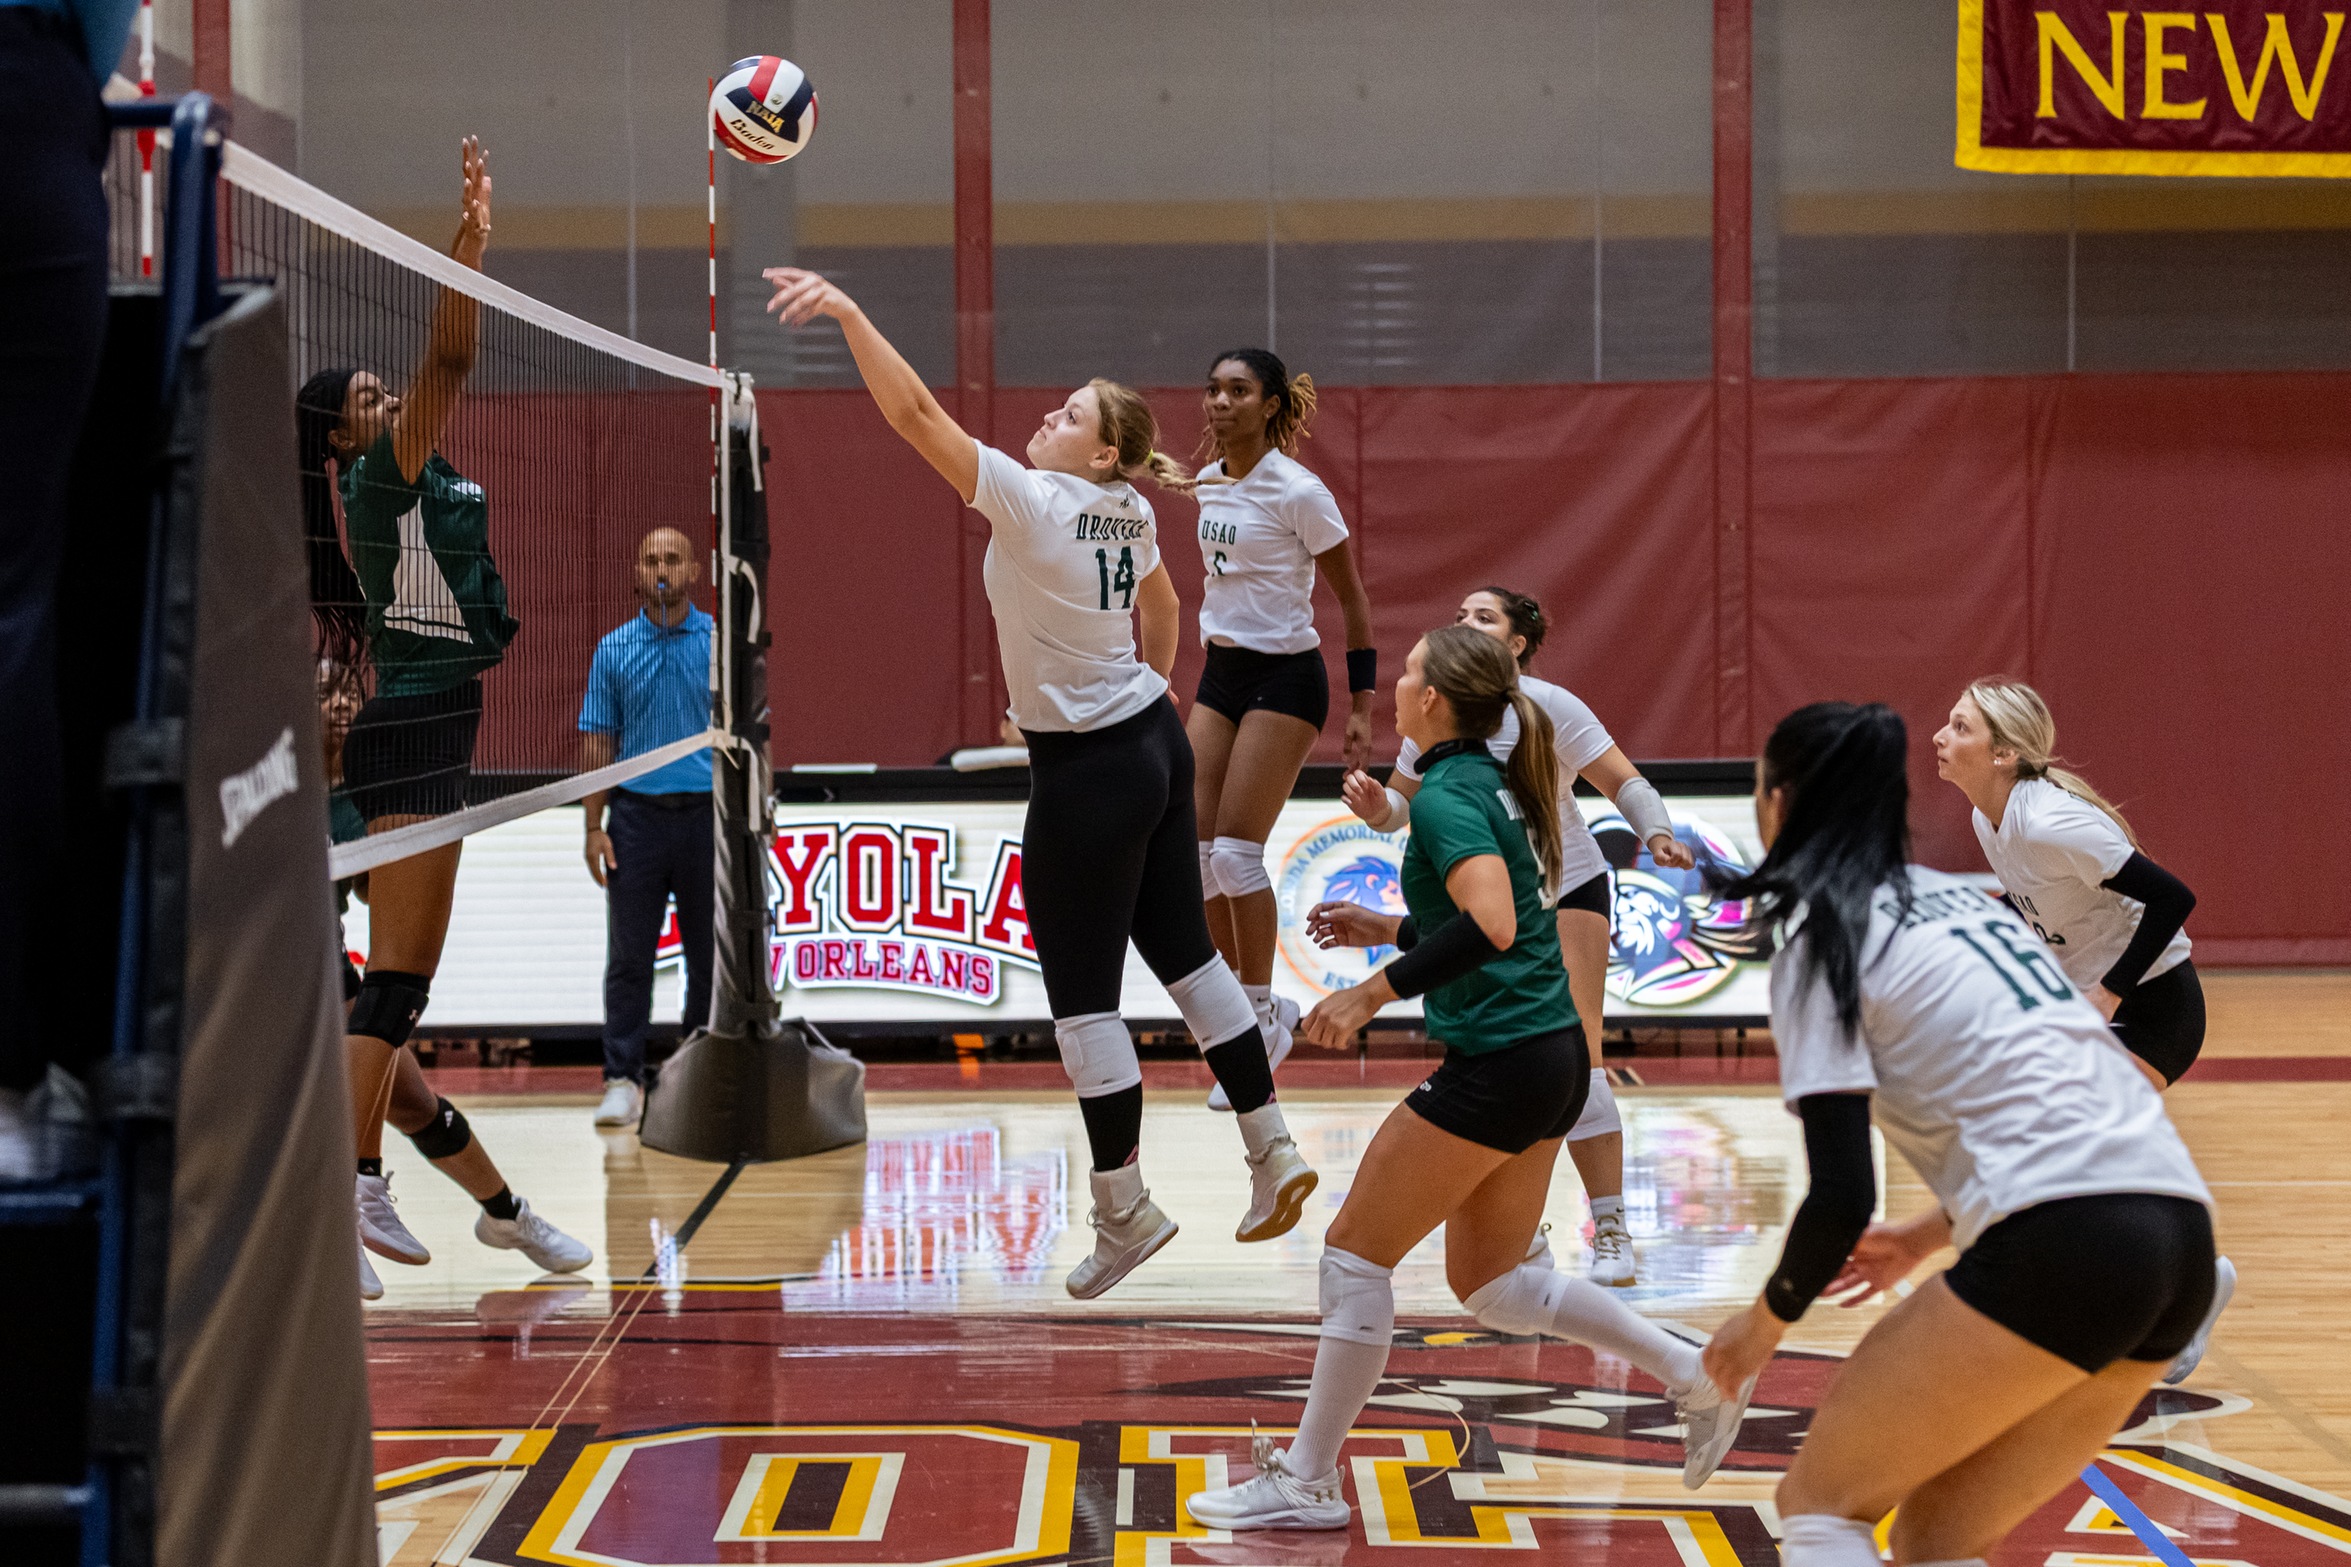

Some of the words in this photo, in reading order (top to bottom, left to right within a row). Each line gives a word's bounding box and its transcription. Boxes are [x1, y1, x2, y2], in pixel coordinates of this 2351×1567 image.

[2034, 11, 2346, 122] NEW
[730, 118, 775, 150] Baden
[745, 100, 784, 133] NAIA
[1201, 519, 1237, 546] USAO
[1095, 546, 1135, 610] 14
[651, 823, 1040, 966] YOLA
[794, 939, 995, 998] ORLEANS
[1950, 920, 2074, 1011] 16
